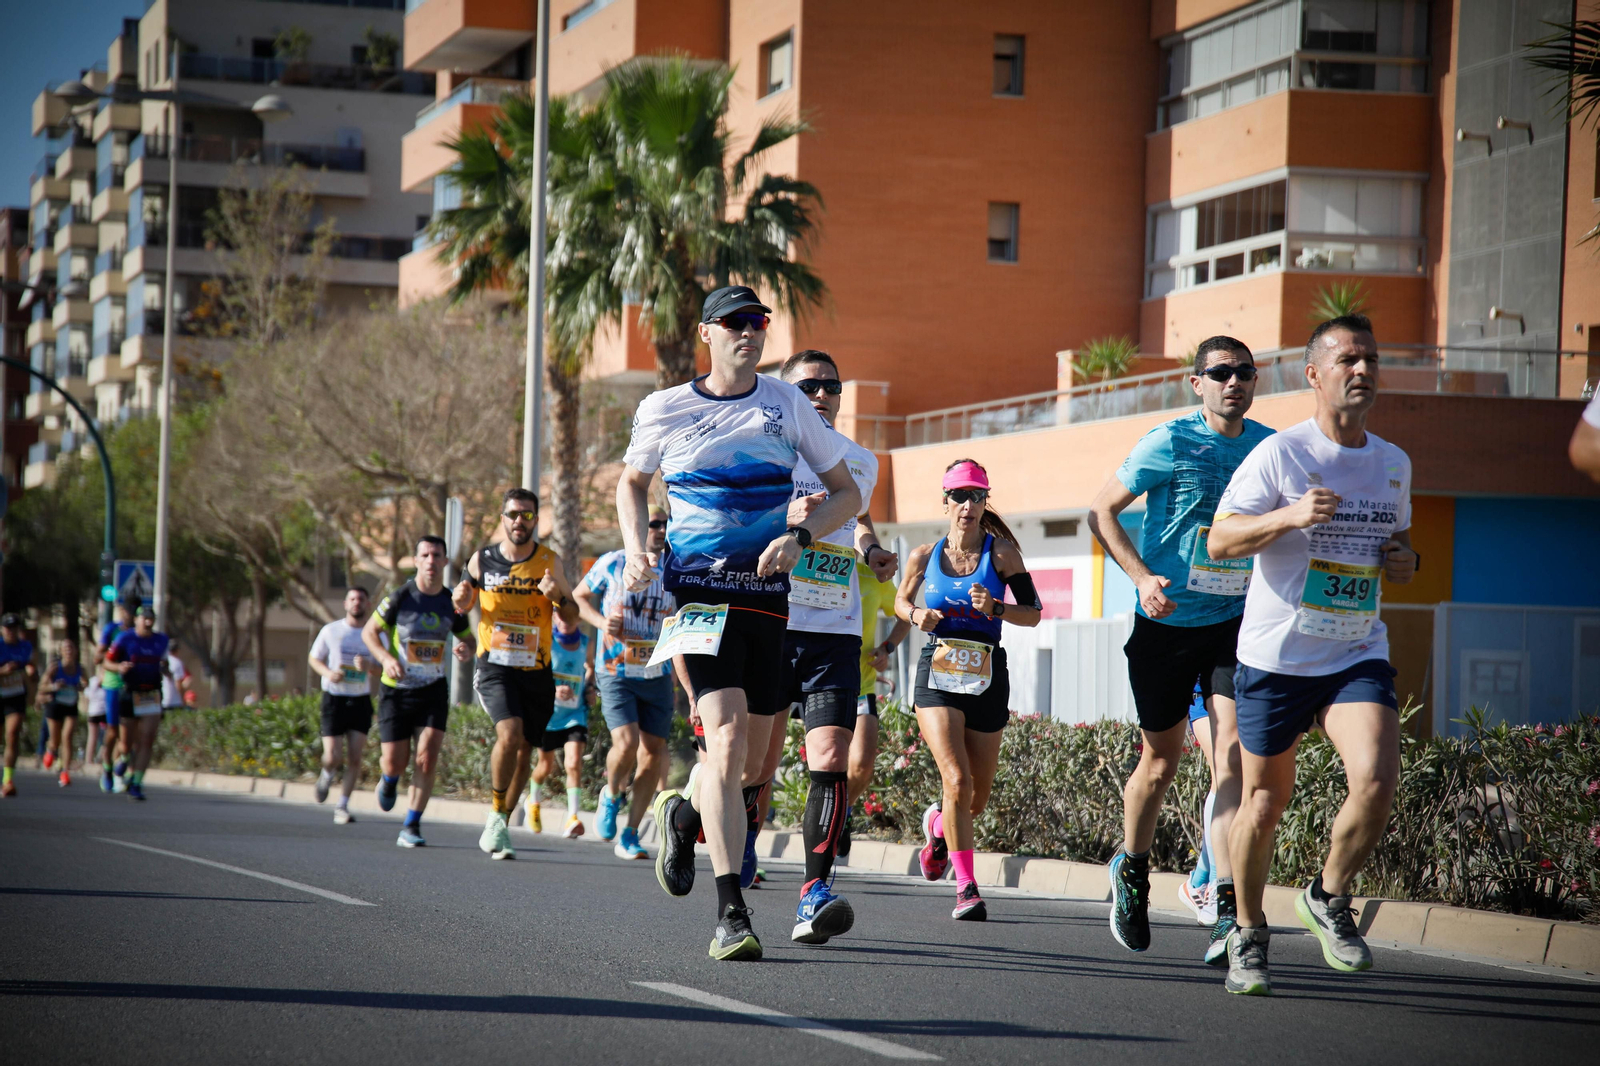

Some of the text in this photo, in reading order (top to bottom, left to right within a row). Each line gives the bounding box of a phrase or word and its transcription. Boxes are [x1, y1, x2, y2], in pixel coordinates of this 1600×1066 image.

[796, 481, 824, 490] Medio
[1337, 499, 1354, 509] dio
[1331, 510, 1397, 524] mería 2024
[804, 551, 851, 577] 1282
[1204, 558, 1224, 566] CARLA
[726, 571, 766, 582] FIGH
[711, 580, 739, 590] WHAT
[743, 581, 762, 591] YOU
[1323, 574, 1370, 601] 349
[1331, 599, 1359, 608] VARGAS
[506, 632, 525, 646] 48
[415, 646, 439, 658] 686
[945, 648, 982, 667] 493
